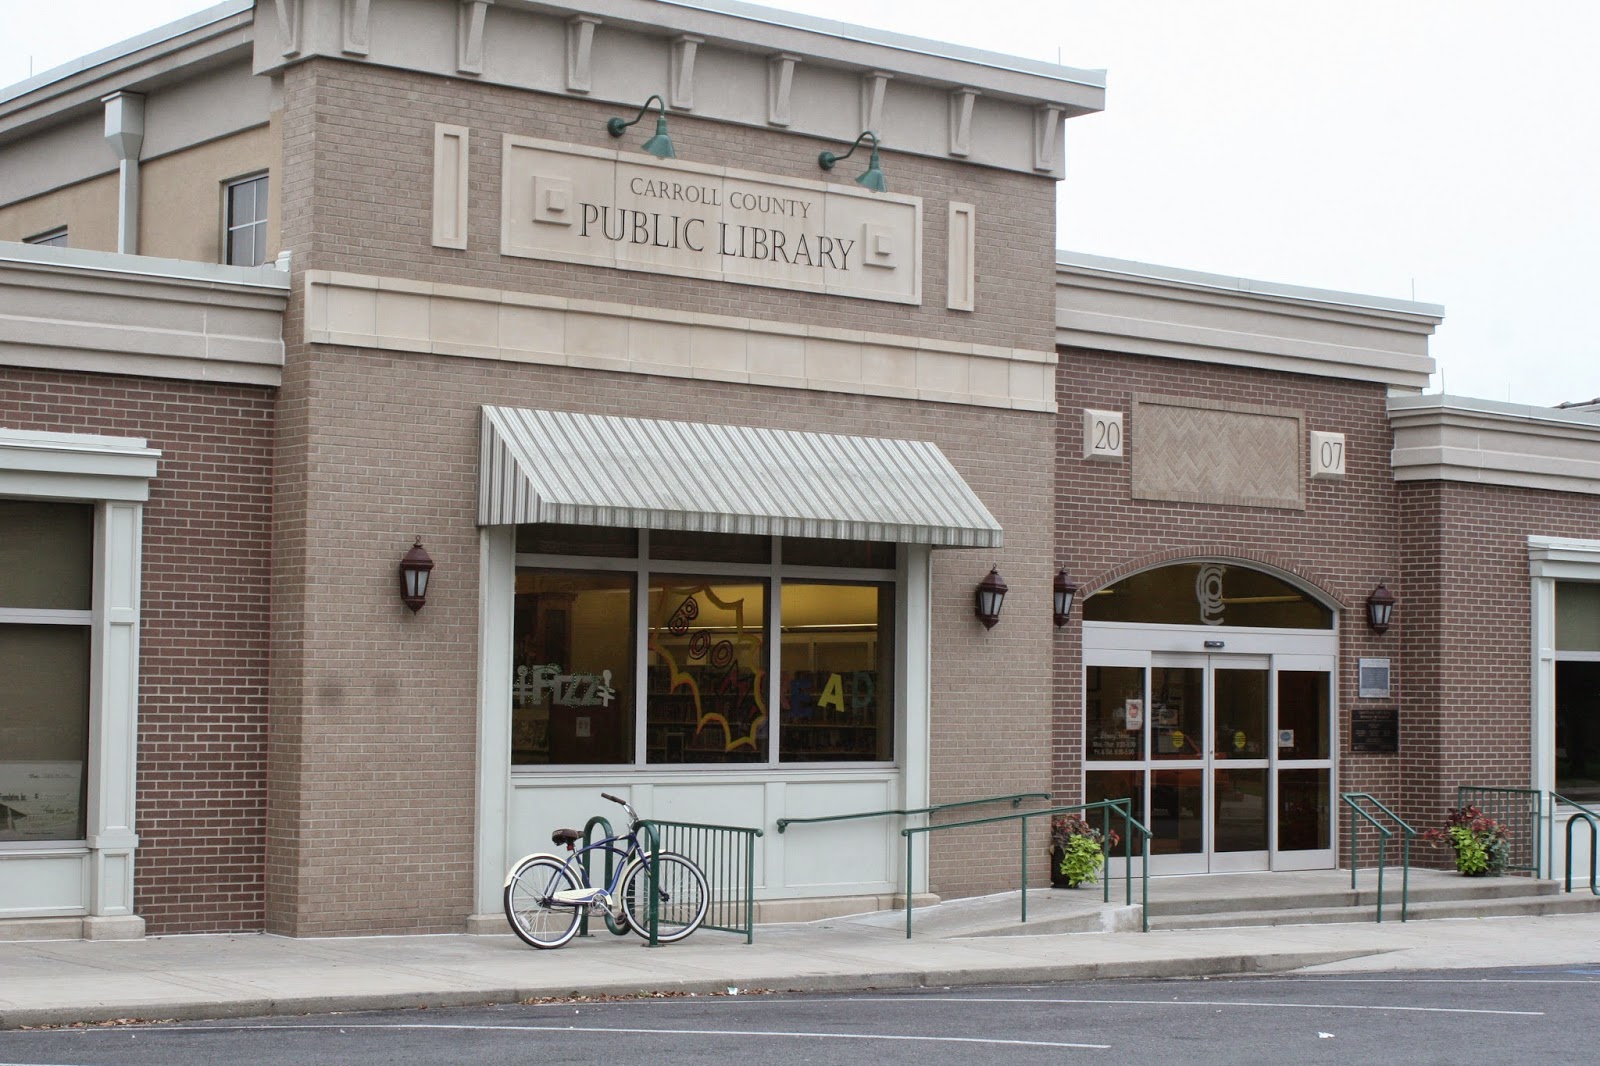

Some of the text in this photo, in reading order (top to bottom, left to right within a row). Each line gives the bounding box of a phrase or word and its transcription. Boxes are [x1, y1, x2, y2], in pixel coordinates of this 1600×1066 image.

[630, 177, 811, 219] CARROLL COUNTY
[578, 202, 856, 271] PUBLIC LIBRARY
[1095, 420, 1120, 450] 20
[1321, 441, 1343, 470] 07
